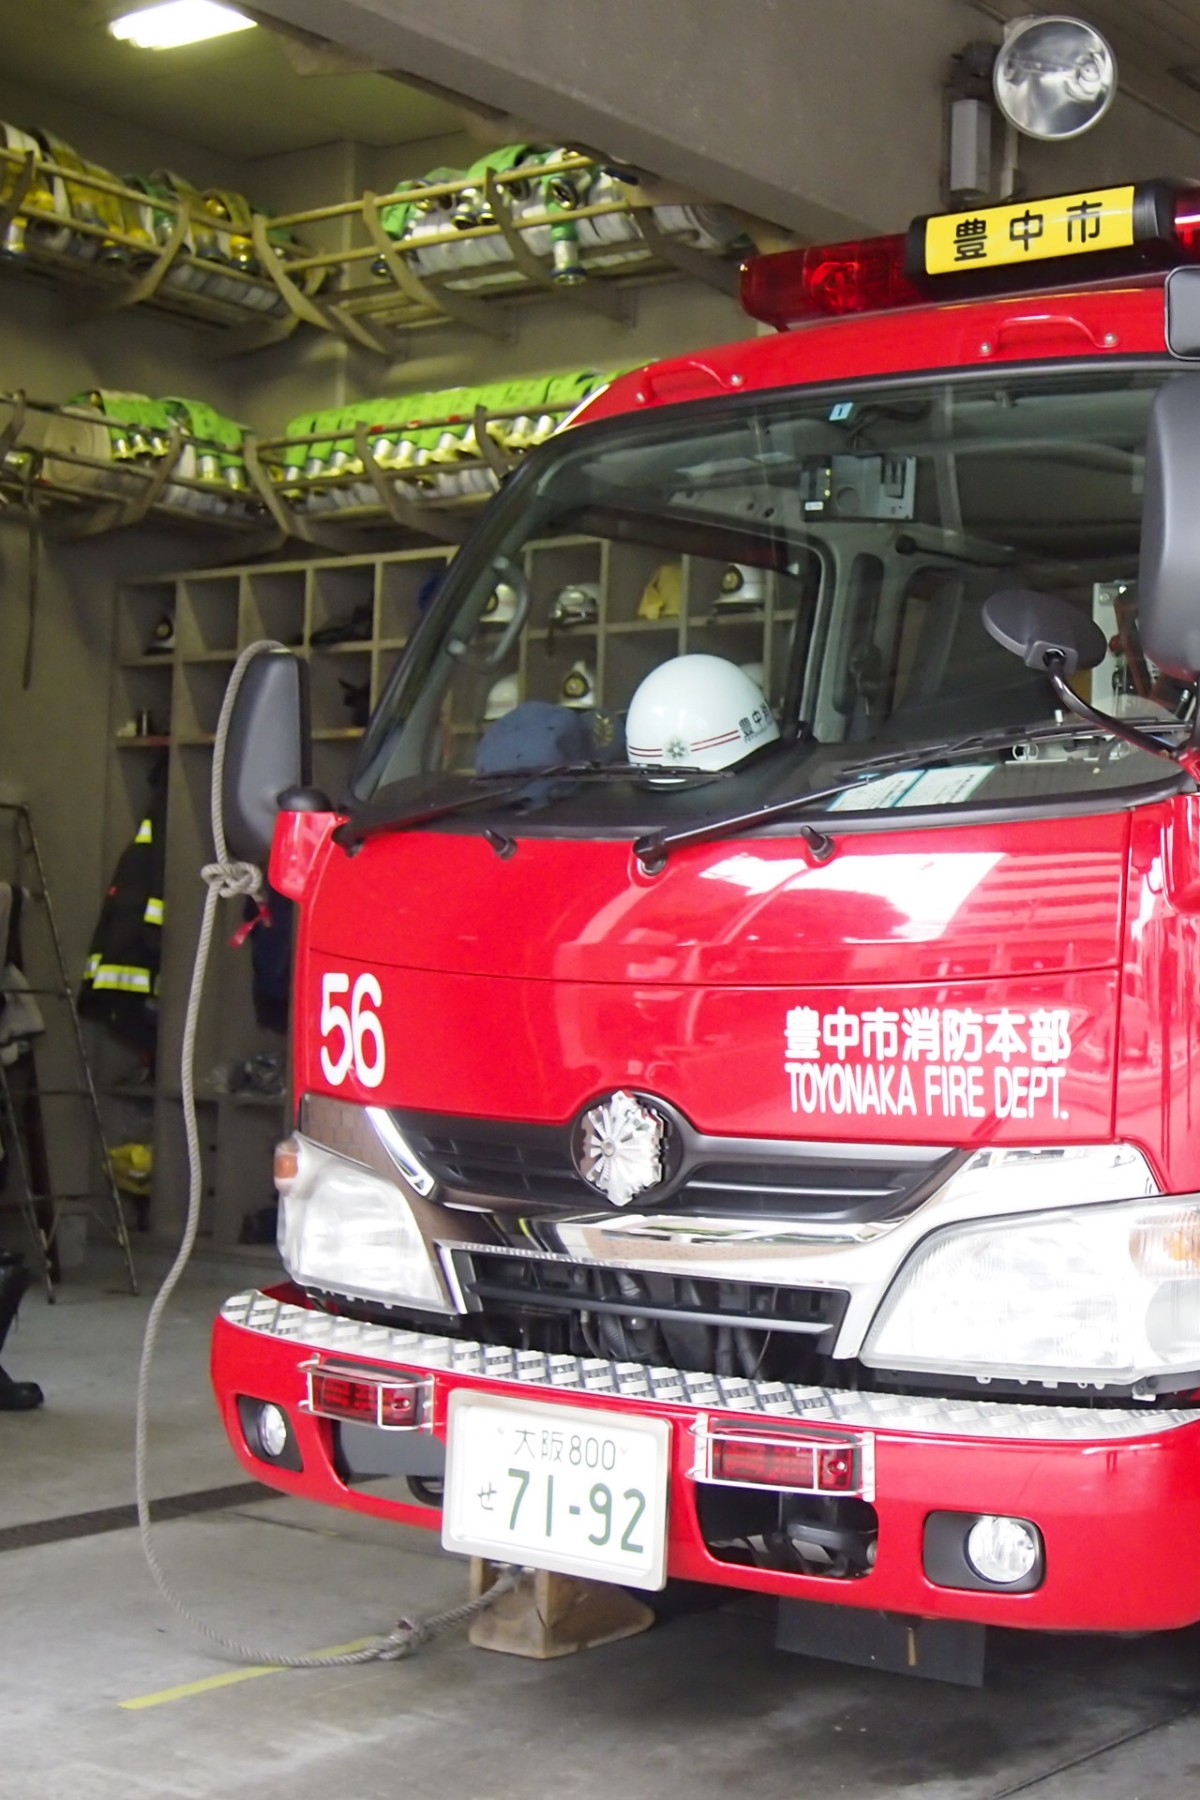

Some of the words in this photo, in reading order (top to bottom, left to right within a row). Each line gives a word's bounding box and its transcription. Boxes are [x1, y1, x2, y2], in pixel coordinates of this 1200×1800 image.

[953, 200, 1103, 262] 豊中市
[320, 972, 386, 1088] 56
[784, 1005, 1073, 1064] 豊中市消防本部
[784, 1062, 918, 1117] TOYONAKA
[924, 1063, 986, 1118] FIRE
[993, 1066, 1070, 1121] DEPT.
[477, 1481, 498, 1511] せ
[508, 1467, 647, 1554] 71-92
